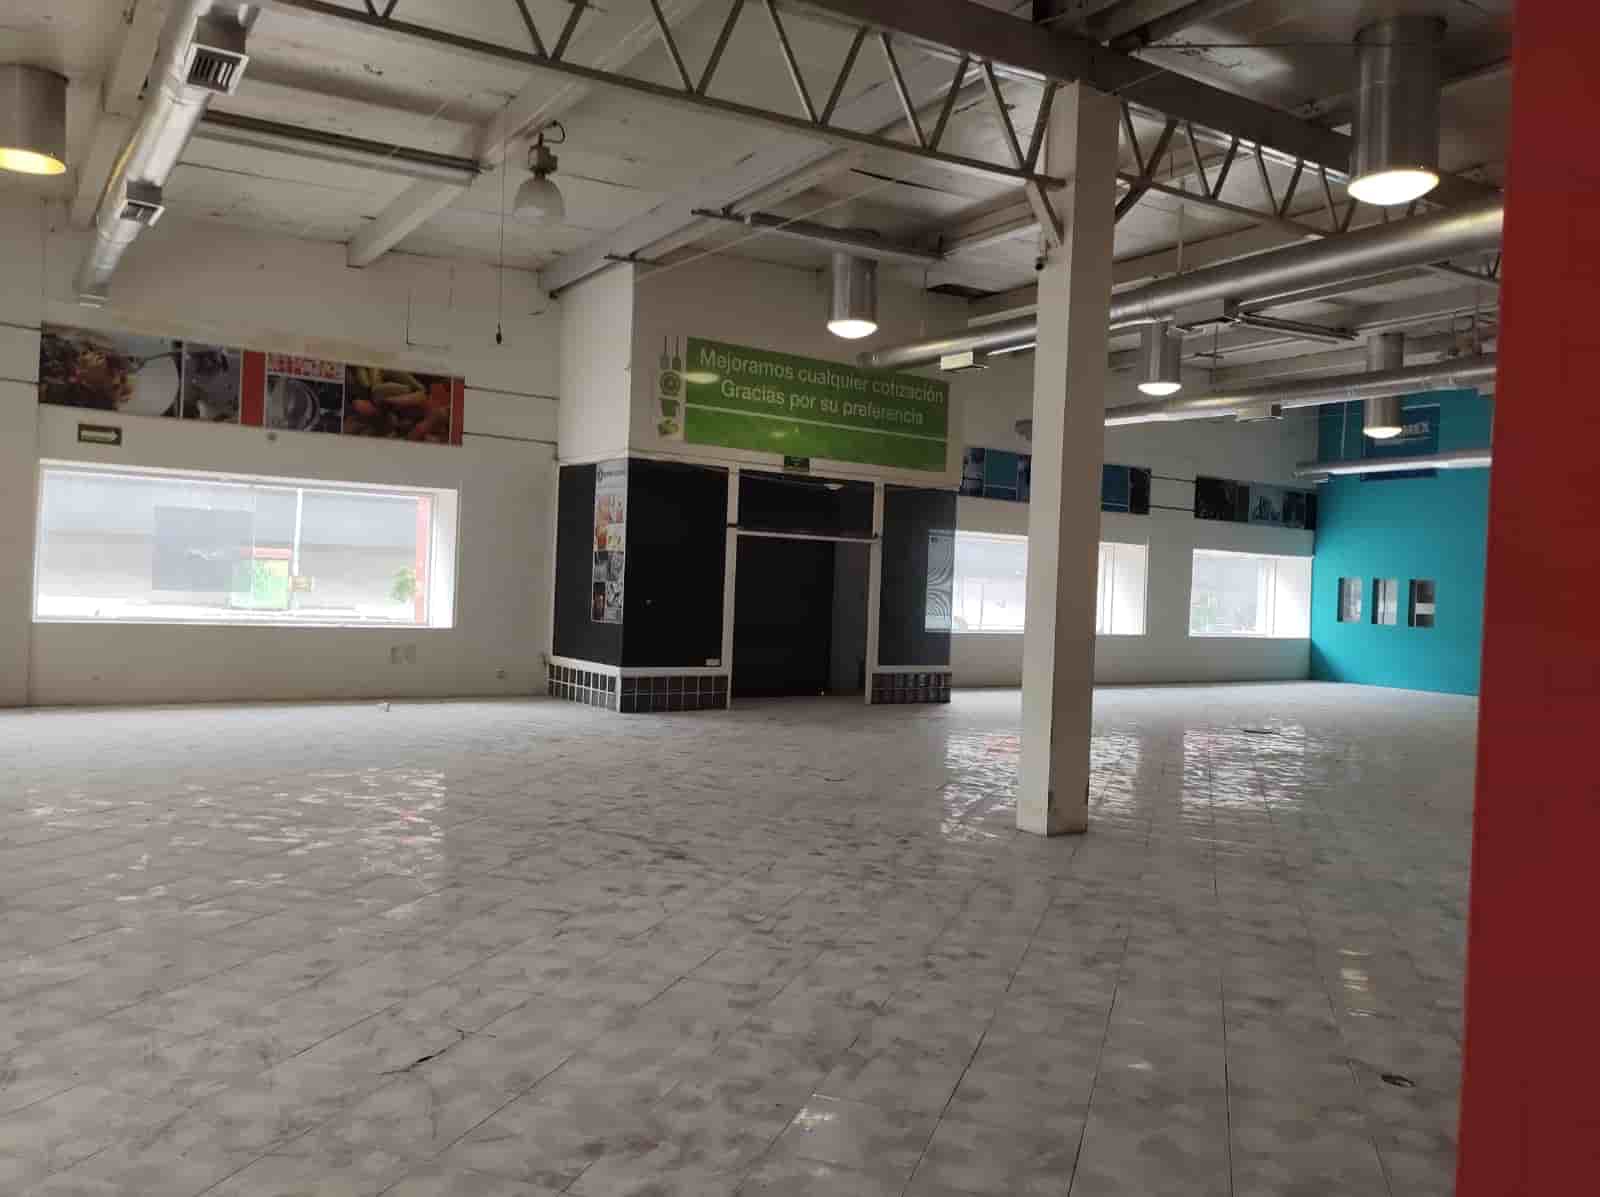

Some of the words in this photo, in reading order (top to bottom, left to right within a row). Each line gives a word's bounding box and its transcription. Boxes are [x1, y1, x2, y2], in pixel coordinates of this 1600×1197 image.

[699, 348, 794, 381] Mejoramos
[797, 367, 869, 393] cualquier
[872, 379, 944, 405] cotización
[721, 379, 785, 405] Gracias
[789, 390, 816, 411] por
[820, 399, 838, 414] su
[842, 400, 923, 425] preferencia
